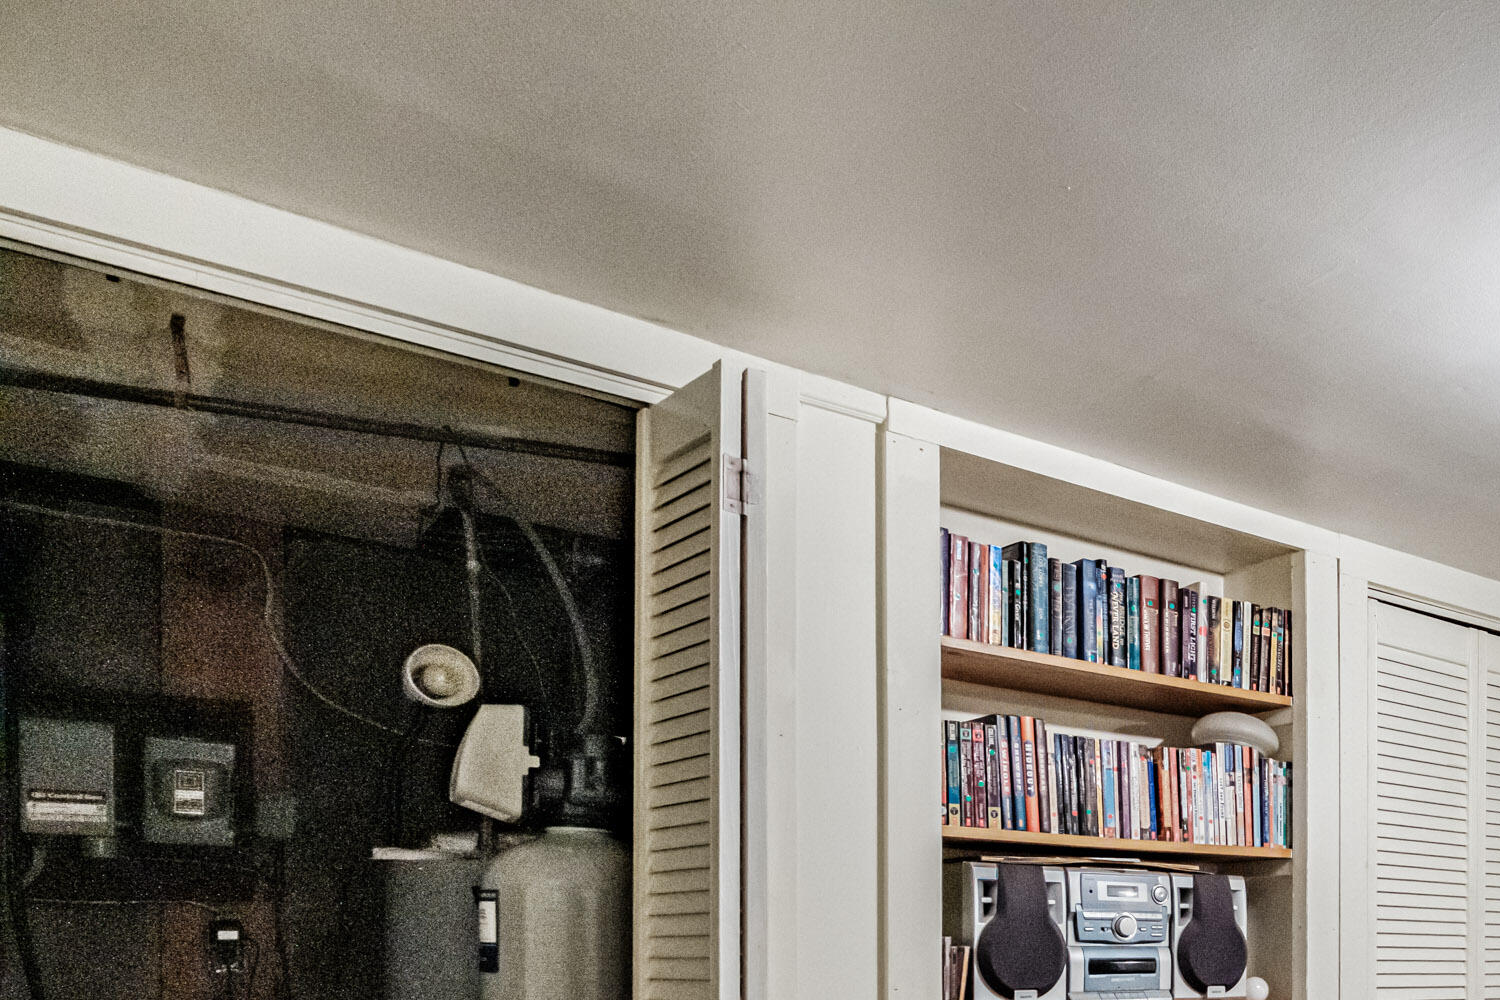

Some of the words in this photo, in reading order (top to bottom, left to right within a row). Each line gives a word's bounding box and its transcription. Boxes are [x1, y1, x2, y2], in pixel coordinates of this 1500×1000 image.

[1188, 637, 1197, 662] LIGHT
[1001, 741, 1010, 794] SWINDLE
[1024, 743, 1035, 794] HIDEOUT
